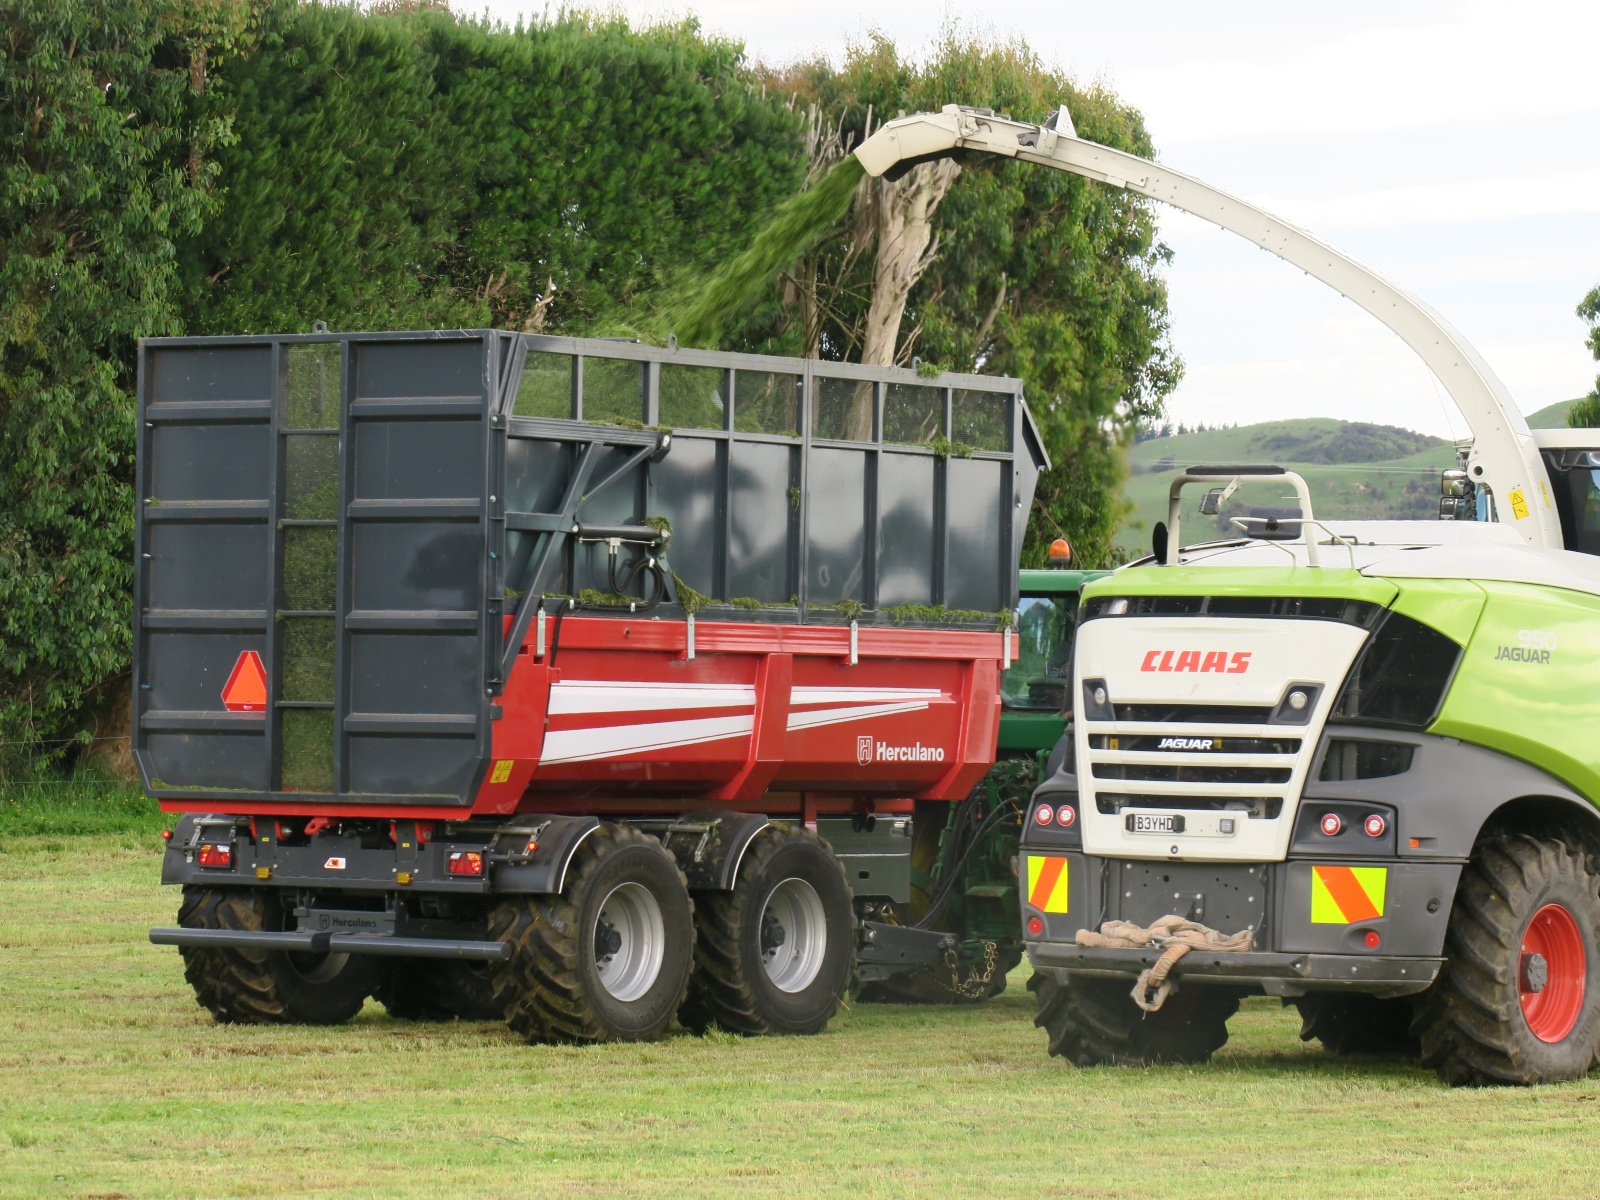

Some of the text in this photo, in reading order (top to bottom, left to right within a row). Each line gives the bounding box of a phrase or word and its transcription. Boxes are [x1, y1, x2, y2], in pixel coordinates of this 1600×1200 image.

[1140, 651, 1252, 673] CLAAS
[1494, 646, 1550, 664] JAGUAR
[876, 742, 945, 762] Herculano
[1158, 738, 1213, 750] JAGUAR
[1137, 817, 1174, 831] B3YHD
